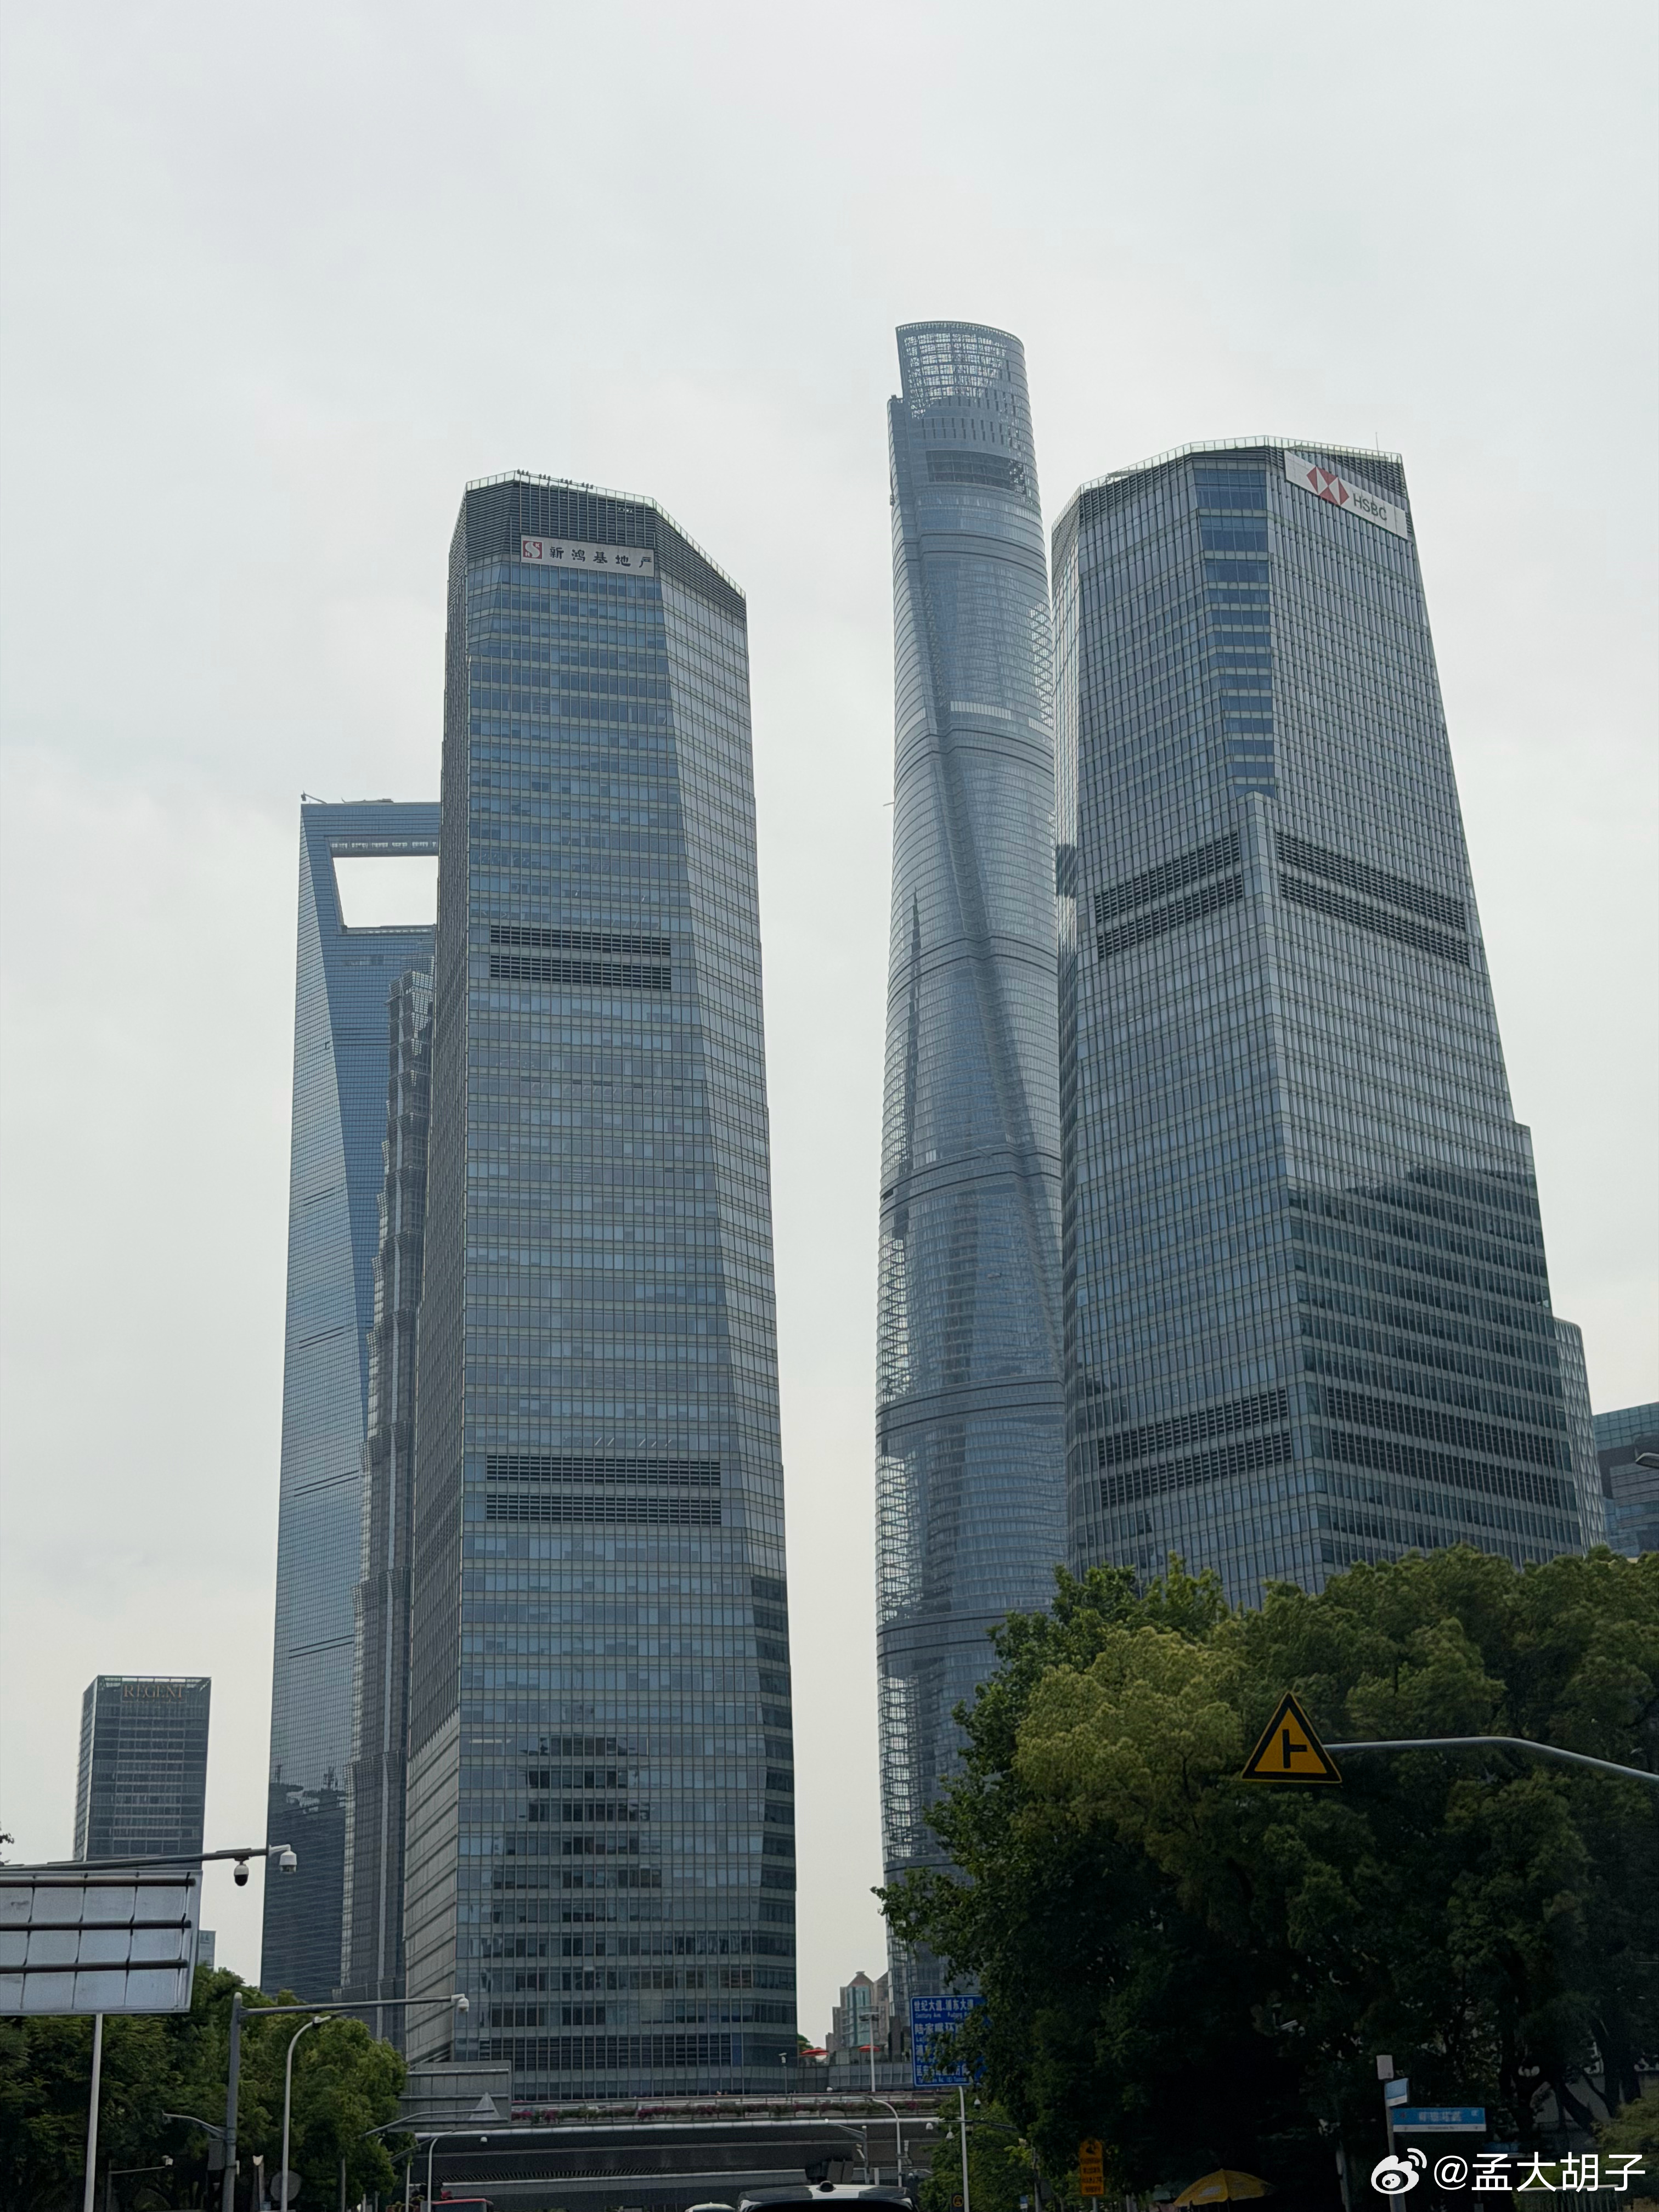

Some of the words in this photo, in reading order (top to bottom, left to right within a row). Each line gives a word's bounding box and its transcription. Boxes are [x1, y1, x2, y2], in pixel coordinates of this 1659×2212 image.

[1352, 493, 1387, 521] HSBC
[549, 546, 652, 568] 新鸿基地产
[123, 1684, 183, 1699] REGENT
